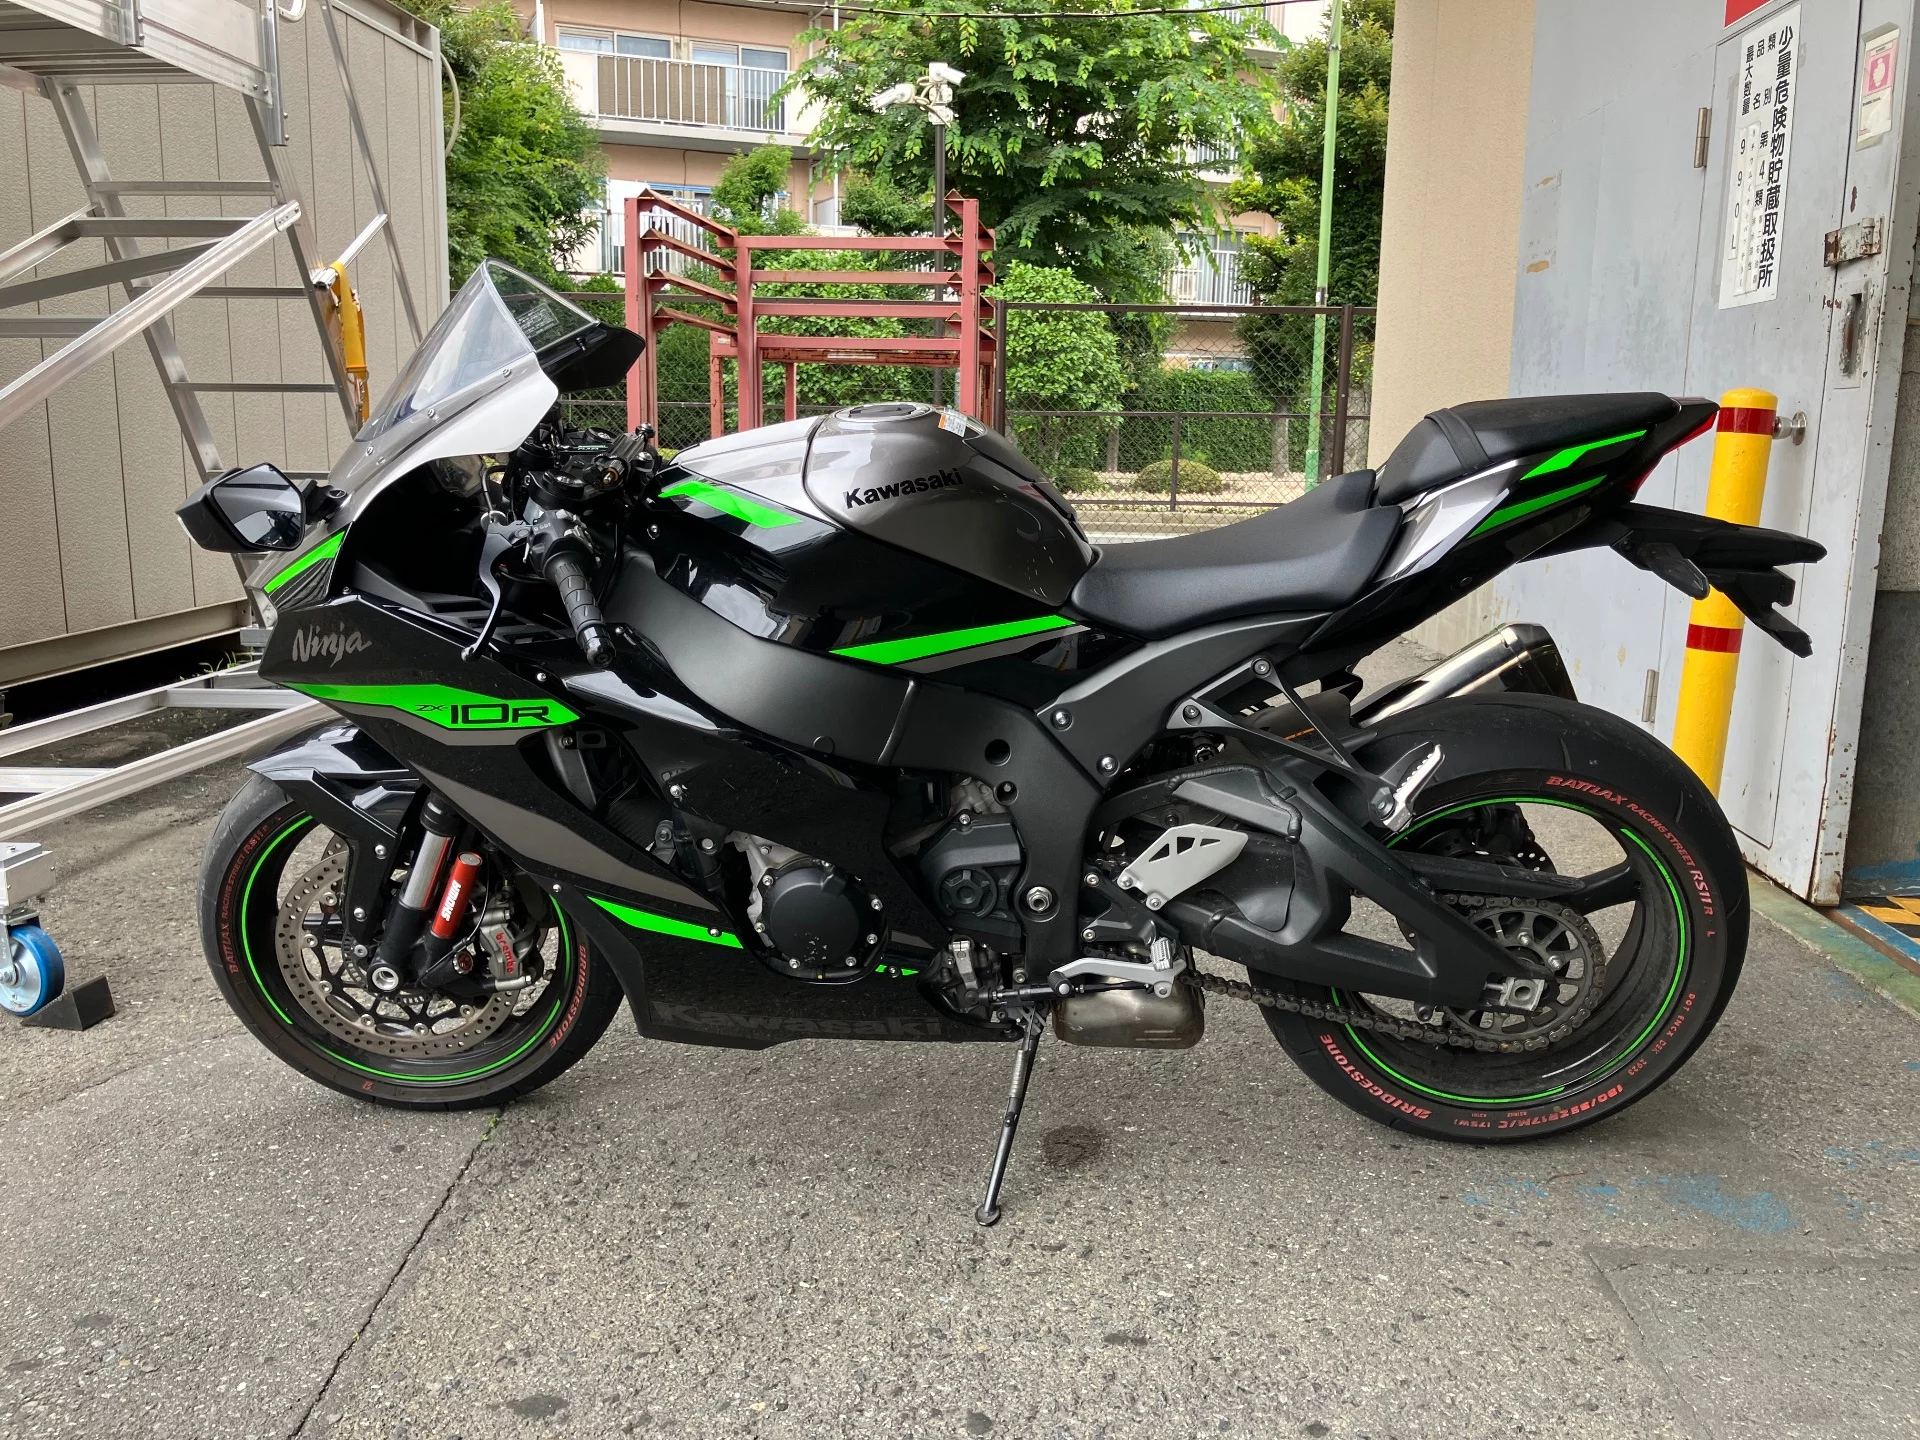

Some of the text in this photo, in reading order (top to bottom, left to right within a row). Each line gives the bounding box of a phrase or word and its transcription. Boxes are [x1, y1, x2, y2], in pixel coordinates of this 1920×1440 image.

[1757, 25, 1793, 289] 少量危険物貯蔵取扱所
[843, 468, 964, 509] Kawasaki
[291, 623, 372, 669] Ninja
[1546, 776, 1628, 805] BATTLAX
[1627, 803, 1667, 834] RACING
[1664, 832, 1696, 867] STREET
[1689, 869, 1713, 904] RS11
[441, 879, 461, 921] SHOWA
[221, 923, 239, 973] BATTLAX
[496, 932, 516, 974] brembo
[549, 945, 587, 1048] BRIDGESTONE
[1683, 993, 1696, 1012] DOT
[1320, 1034, 1432, 1119] BRIDGESTONE
